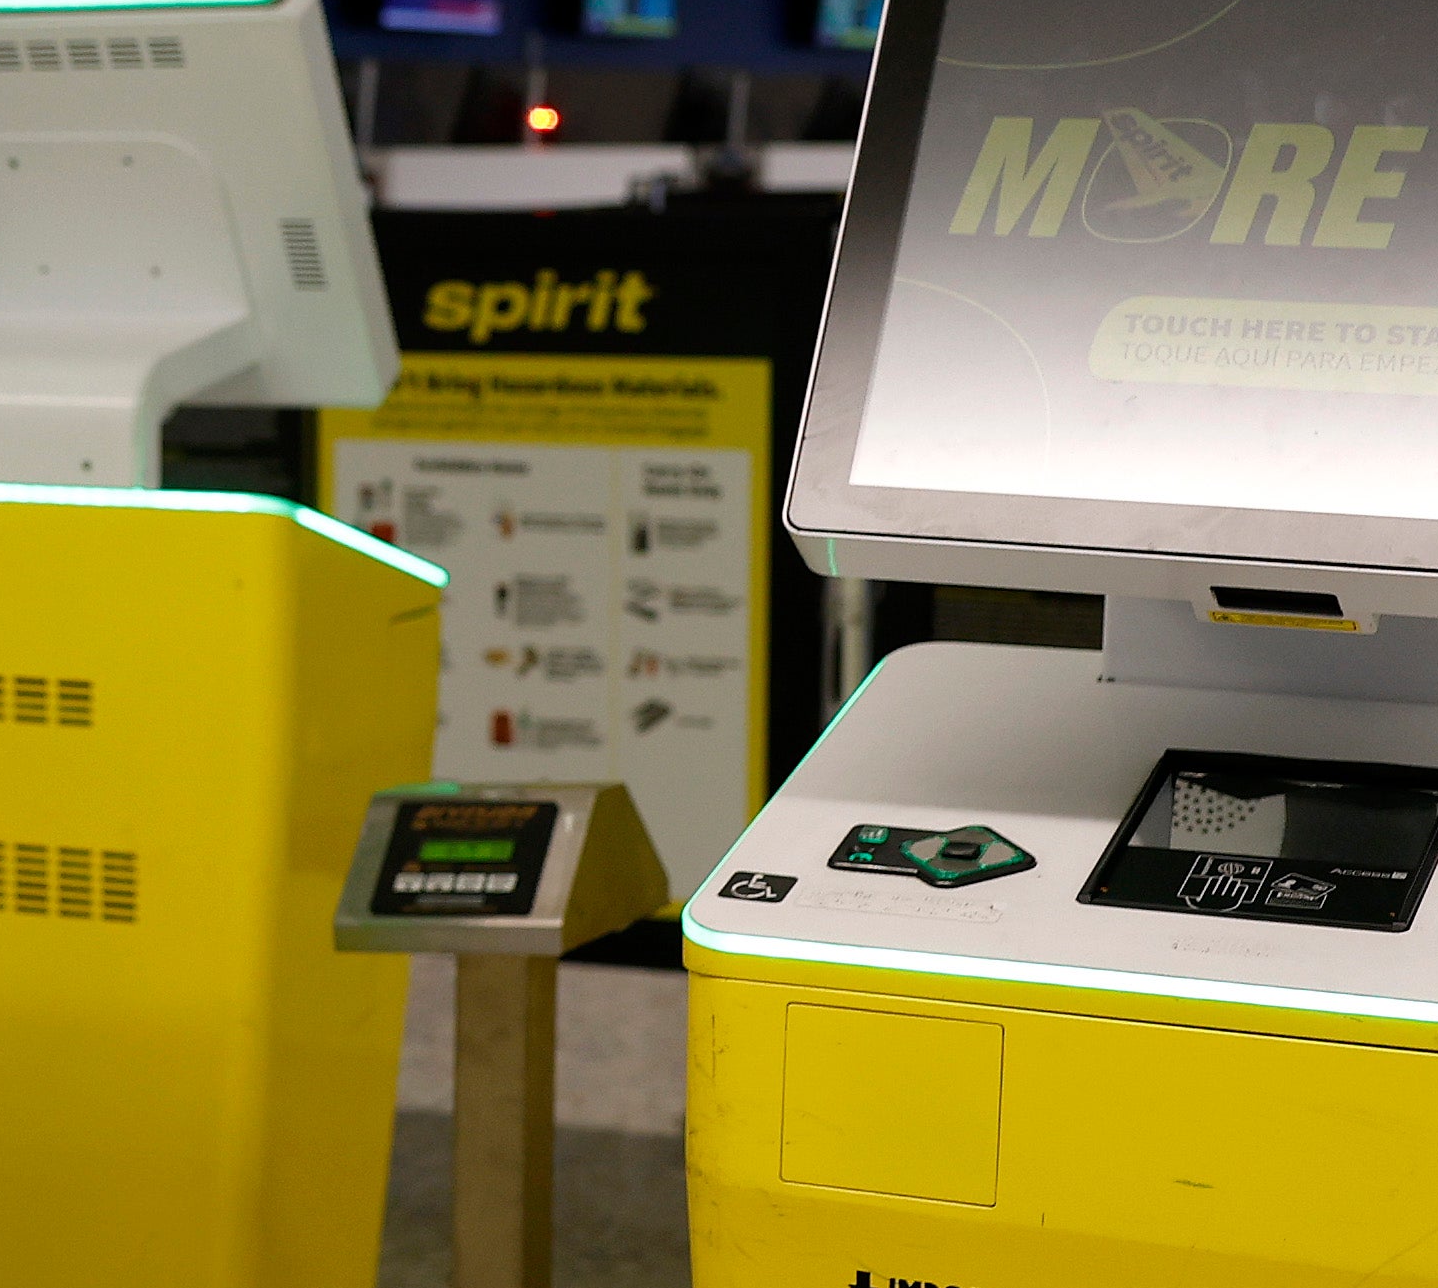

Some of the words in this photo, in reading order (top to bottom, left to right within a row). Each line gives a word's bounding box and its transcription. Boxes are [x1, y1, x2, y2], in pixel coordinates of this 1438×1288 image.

[948, 111, 1428, 248] MORE
[425, 268, 658, 345] spirit
[1124, 313, 1232, 338] TOUCH
[1242, 319, 1324, 342] HERE
[1334, 321, 1376, 345] TO
[1124, 342, 1207, 367] TOQUE
[1286, 348, 1352, 371] PARA
